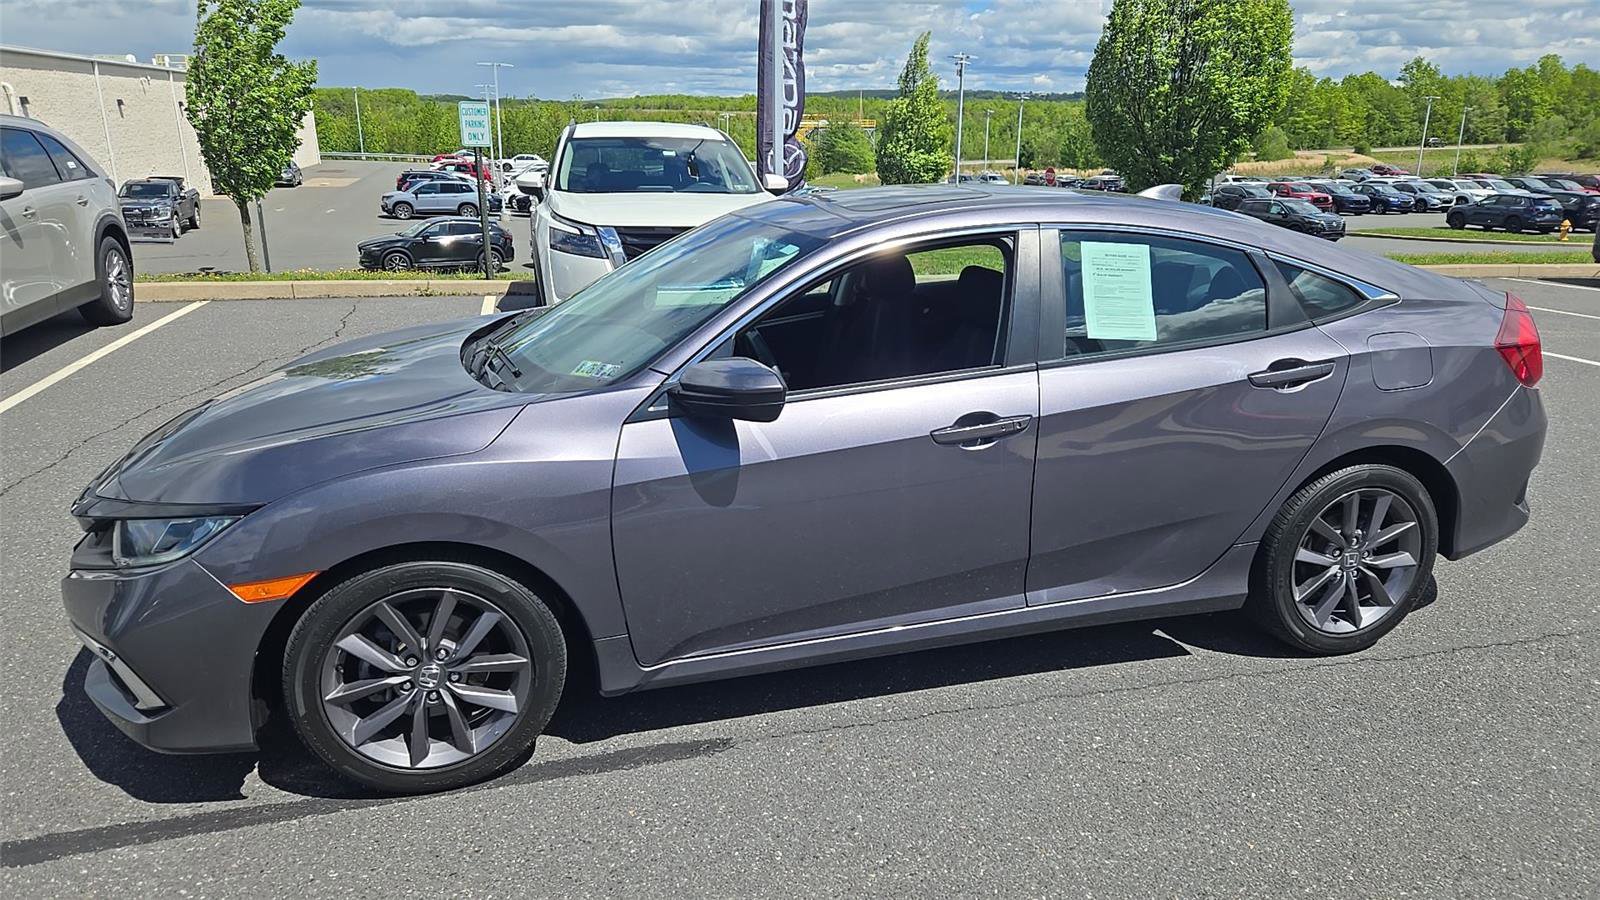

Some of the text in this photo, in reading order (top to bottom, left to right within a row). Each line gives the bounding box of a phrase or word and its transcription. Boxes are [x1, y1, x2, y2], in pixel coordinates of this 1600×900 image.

[462, 107, 487, 116] CUSTOMER
[465, 120, 486, 128] PARKING
[467, 132, 485, 141] ONLY
